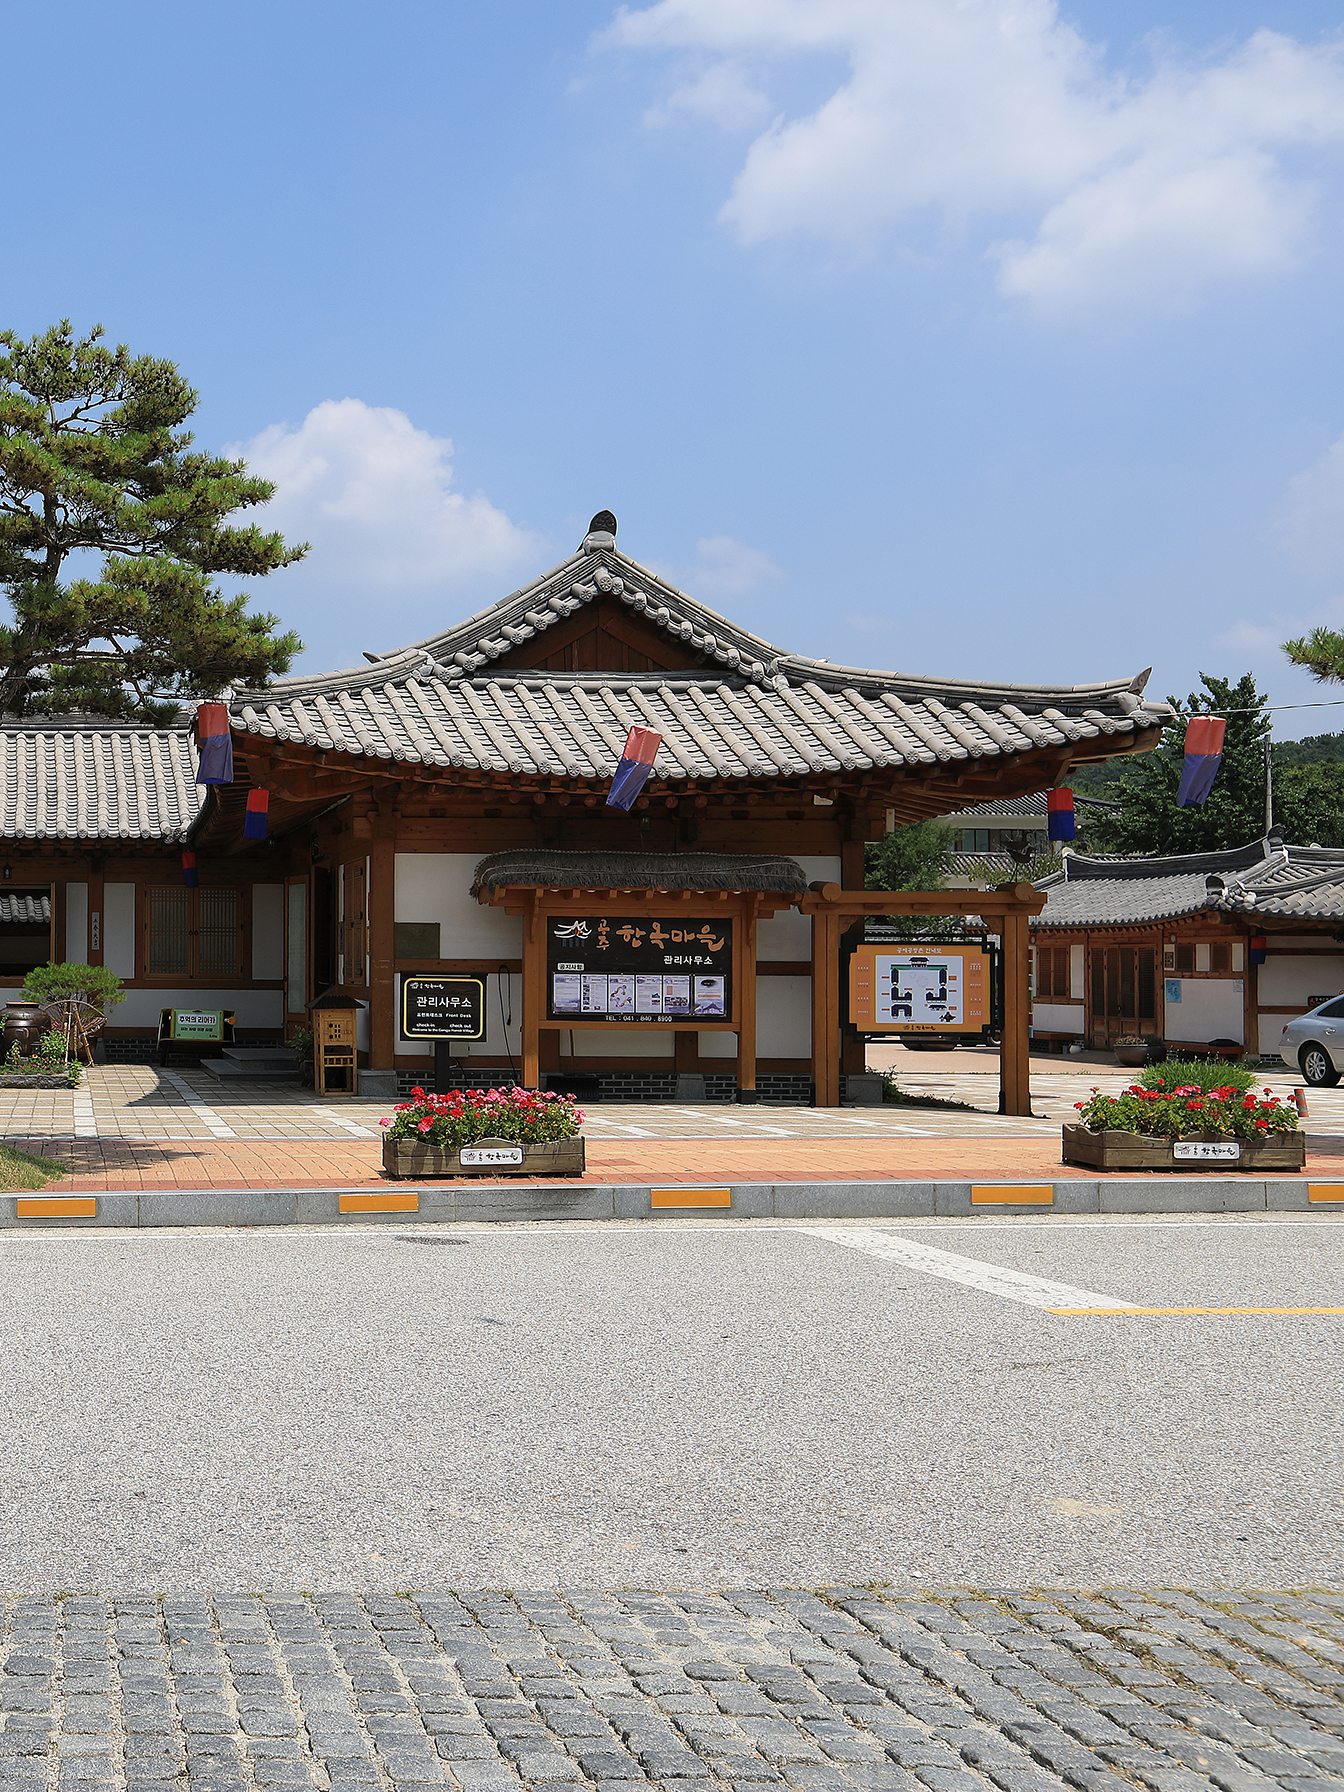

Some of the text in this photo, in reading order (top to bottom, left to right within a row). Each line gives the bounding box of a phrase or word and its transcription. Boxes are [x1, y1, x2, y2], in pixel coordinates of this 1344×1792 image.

[596, 919, 725, 952] 공주 한옥마을
[663, 955, 713, 965] 관리사무소
[416, 996, 472, 1008] 관리사무소
[179, 1015, 216, 1024] 추억의 리어카
